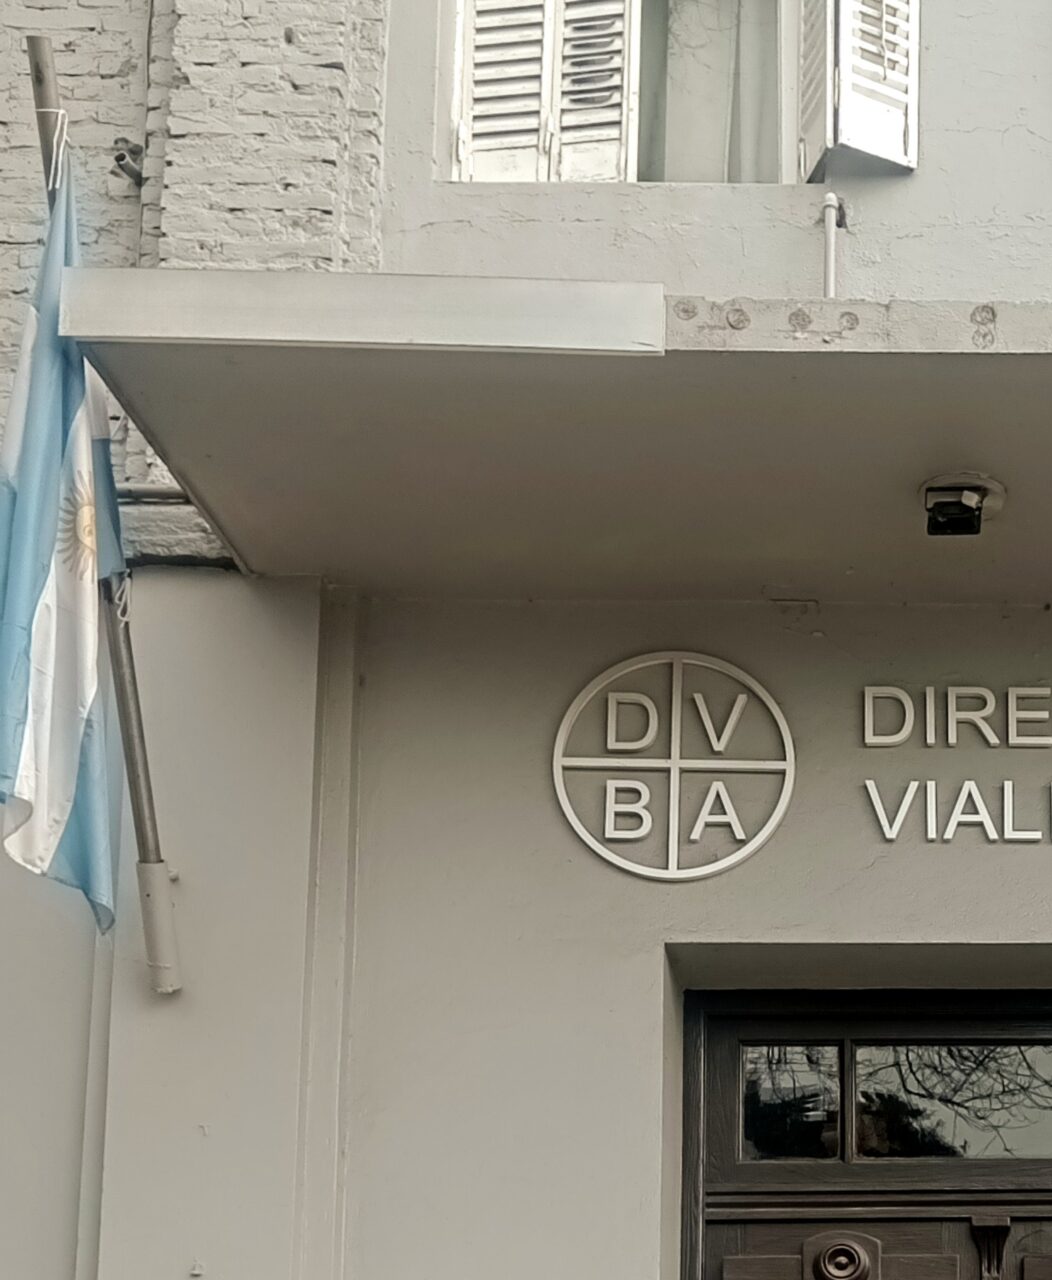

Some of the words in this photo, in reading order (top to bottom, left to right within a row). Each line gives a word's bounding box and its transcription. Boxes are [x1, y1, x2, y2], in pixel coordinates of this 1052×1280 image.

[606, 691, 660, 752] D
[692, 692, 749, 754] V
[604, 779, 653, 841] B
[689, 780, 747, 842] A
